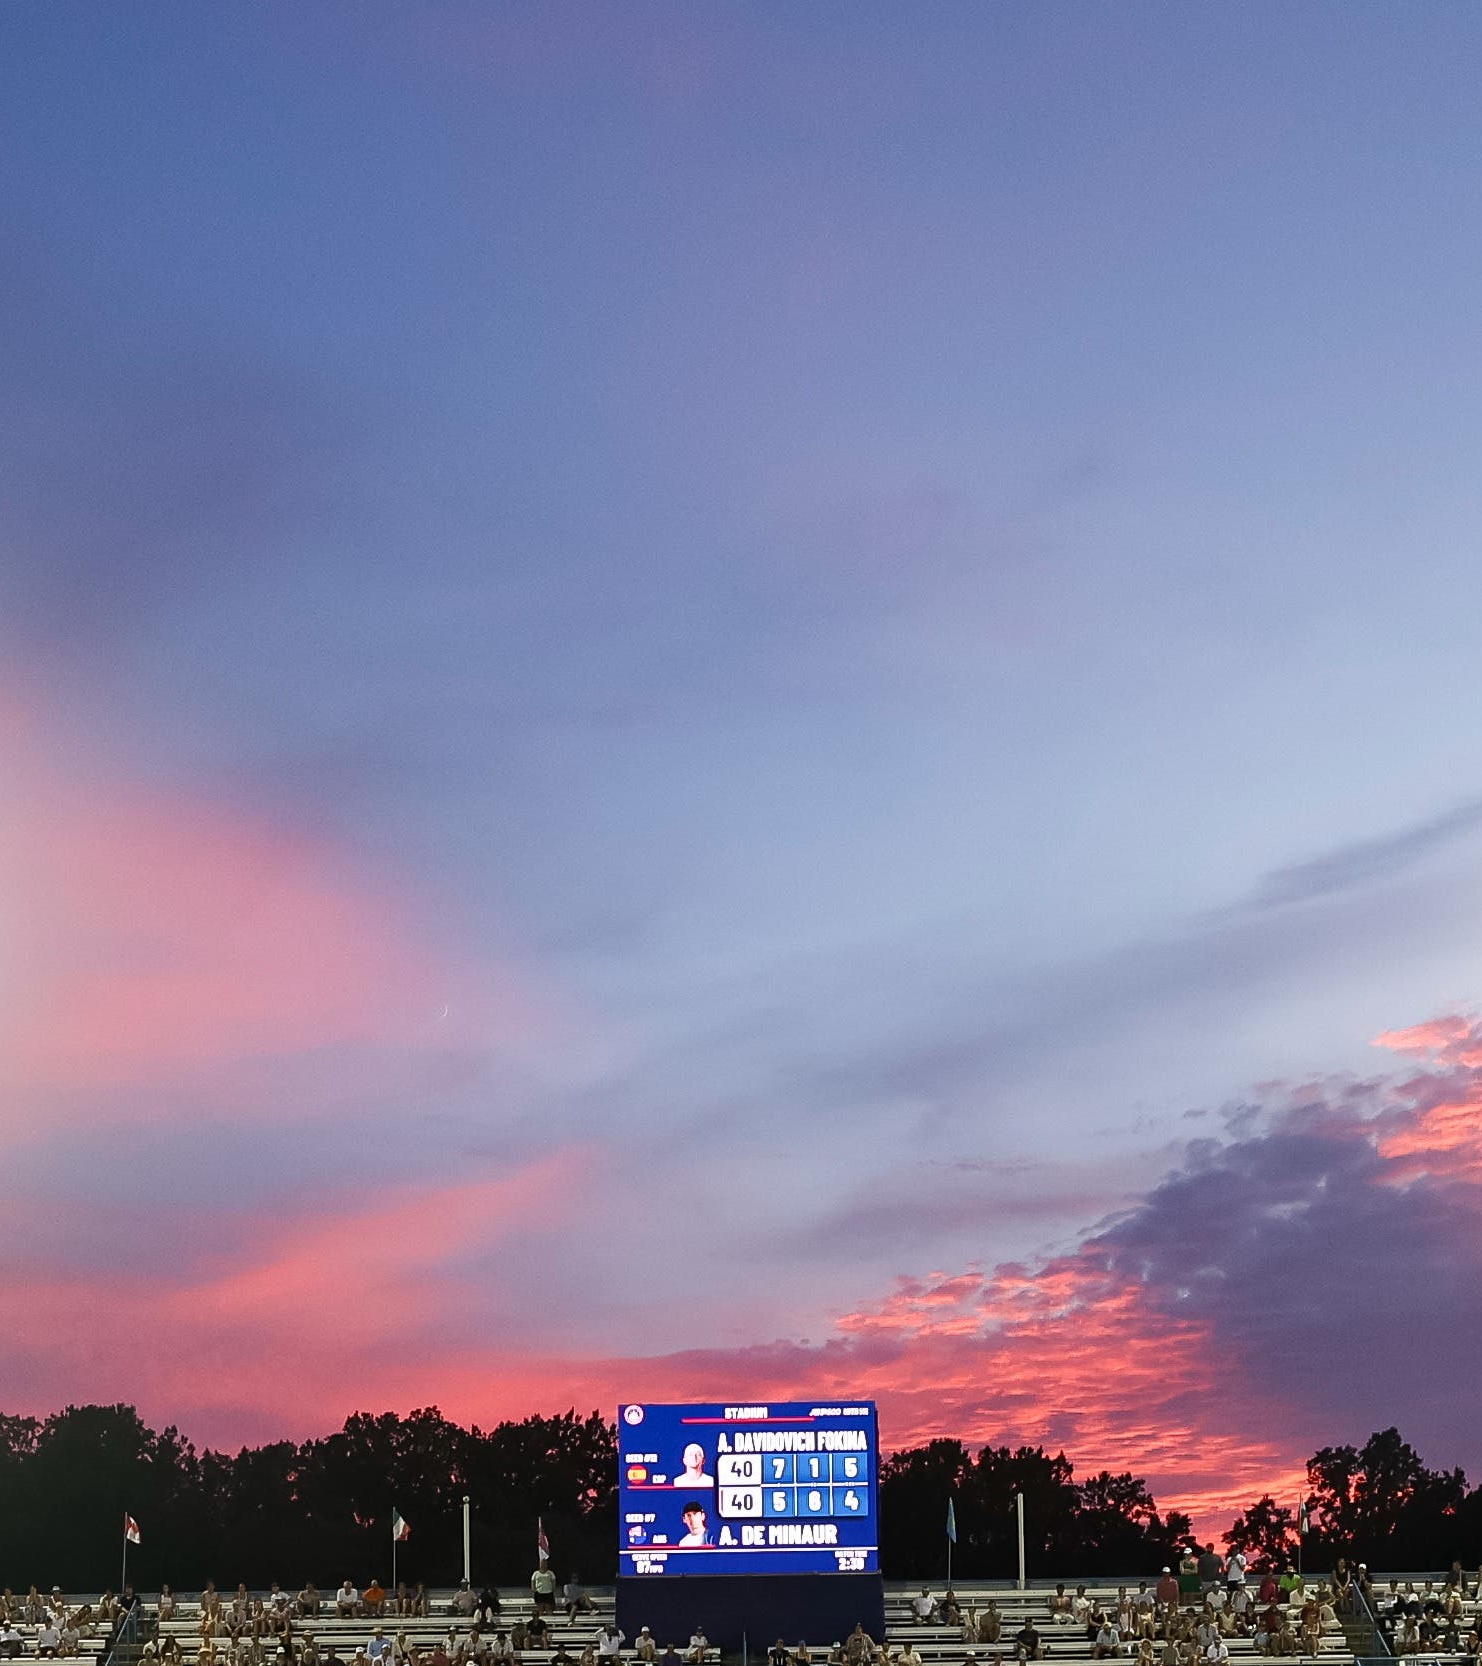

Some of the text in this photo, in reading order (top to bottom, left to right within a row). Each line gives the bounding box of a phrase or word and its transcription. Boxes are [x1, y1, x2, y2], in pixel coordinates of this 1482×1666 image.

[725, 1407, 768, 1419] STADIUM
[718, 1431, 867, 1452] A. DAVIDOVICH FOKINA
[731, 1457, 858, 1479] 40 7 1 5
[731, 1494, 753, 1510] 40
[772, 1491, 786, 1512] 5
[844, 1490, 859, 1511] 4
[719, 1524, 838, 1546] A. DE MINAUR
